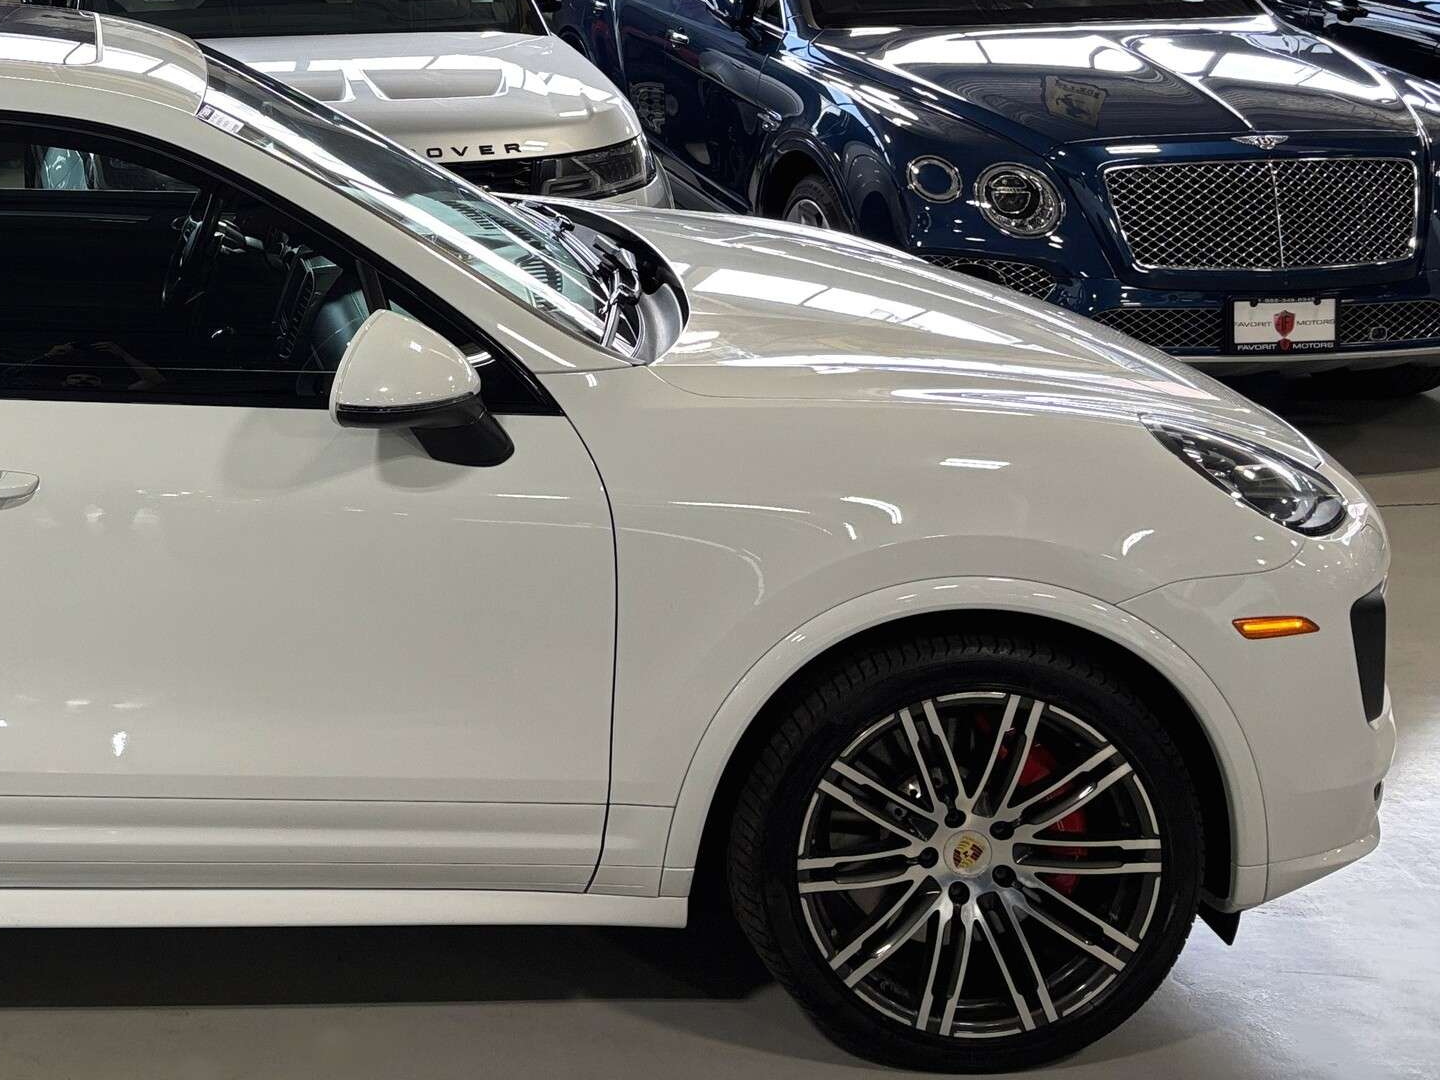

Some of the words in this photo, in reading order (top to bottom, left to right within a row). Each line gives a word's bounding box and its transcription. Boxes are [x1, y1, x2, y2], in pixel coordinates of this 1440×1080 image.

[410, 142, 522, 159] OVER
[1237, 343, 1278, 351] FAVORIT
[1292, 342, 1335, 350] MOTORS
